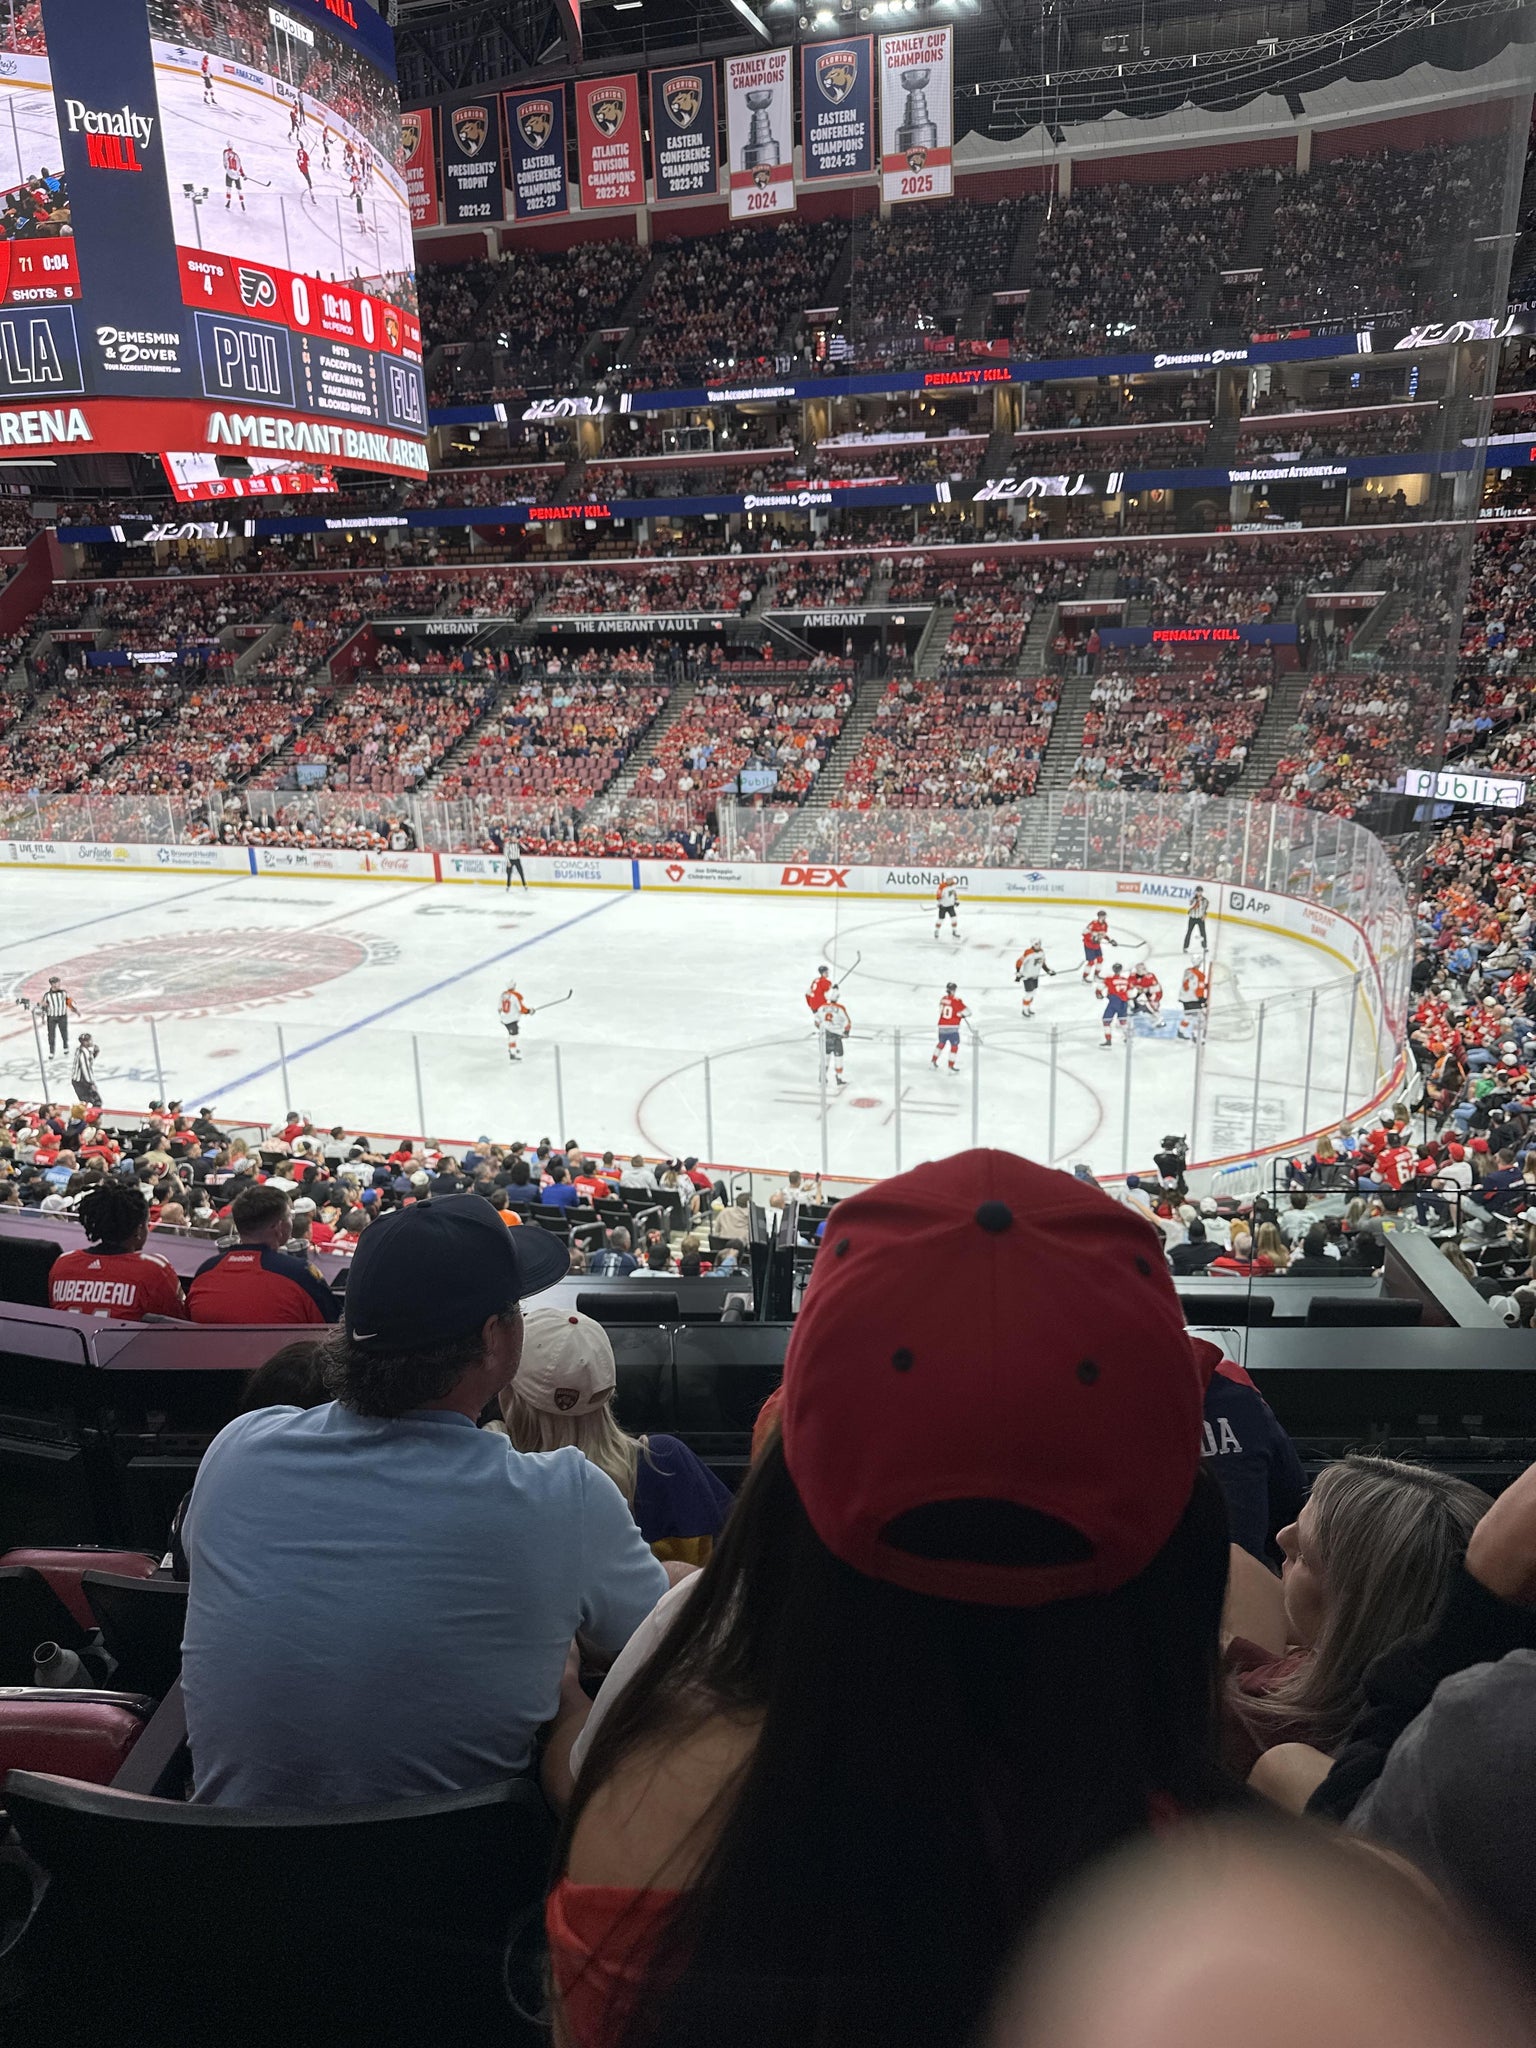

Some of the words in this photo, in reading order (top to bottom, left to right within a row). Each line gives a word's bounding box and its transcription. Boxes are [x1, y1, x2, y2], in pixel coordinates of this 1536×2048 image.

[885, 36, 925, 55] STANLEY
[925, 32, 947, 48] CUP
[730, 60, 768, 76] STANLEY
[768, 54, 787, 69] CUP
[820, 54, 853, 67] FLORIDA
[887, 48, 944, 69] CHAMPIONS
[667, 80, 698, 92] FLORIDA
[732, 69, 785, 90] CHAMPIONS
[593, 91, 622, 102] FLORIDA
[456, 110, 484, 120] FLORIDA
[521, 104, 549, 115] FLORIDA
[817, 108, 857, 127] EASTERN
[64, 99, 153, 149] Penalty
[810, 123, 865, 142] CONFERENCE
[591, 142, 630, 158] ATLANTIC
[667, 133, 703, 150] EASTERN
[811, 139, 864, 157] CHAMPIONS
[86, 133, 142, 171] KILL
[659, 146, 711, 165] CONFERENCE
[448, 161, 497, 177] PRESIDENTS'
[522, 153, 556, 171] EASTERN
[592, 156, 630, 172] DIVISION
[661, 159, 710, 178] CHAMPIONS
[819, 154, 857, 169] 2024-25
[457, 174, 488, 190] TROPHY
[516, 168, 562, 185] CONFERENCE
[587, 170, 636, 186] CHAMPIONS
[901, 174, 933, 195] 2025
[518, 182, 561, 198] CHAMPIONS
[595, 184, 630, 199] 2023-24
[669, 179, 704, 192] 2023-24
[408, 193, 431, 206] PIONS
[526, 195, 557, 210] 2022-23
[747, 191, 777, 211] 2024
[458, 203, 491, 217] 2021-22
[19, 257, 33, 272] 71
[42, 254, 69, 271] 0:04
[187, 261, 224, 277] SHOTS
[12, 287, 58, 300] SHOTS:
[64, 287, 74, 298] 5
[203, 275, 213, 295] 4
[291, 278, 310, 326] 0
[321, 293, 352, 323] 10:10
[360, 298, 375, 344] 0
[0, 319, 64, 385] LA
[105, 347, 117, 359] &
[119, 344, 178, 363] DOVER
[213, 327, 281, 395] PHI
[924, 371, 982, 386] PENALTY
[983, 367, 1012, 381] KILL
[0, 409, 93, 445] RENA
[208, 412, 343, 456] AMERANT
[343, 428, 392, 464] BANK
[391, 437, 429, 472] ARENA
[529, 507, 581, 520] PENALTY
[583, 504, 611, 518] KILL
[574, 622, 597, 633] THE
[598, 621, 655, 632] AMERANT
[658, 619, 699, 630] VAULT
[803, 613, 867, 627] AMERANT
[426, 623, 480, 635] AMERANT
[1152, 629, 1211, 642] PENALTY
[1212, 628, 1241, 641] KILL
[1418, 773, 1503, 805] Publix
[553, 860, 600, 870] COMCAST
[554, 870, 602, 880] BUSINESS
[781, 867, 851, 888] DEX
[886, 871, 969, 887] AutoNaton
[1142, 883, 1197, 899] AMAZIN
[1246, 897, 1271, 915] App
[228, 1255, 254, 1263] Reebok
[53, 1280, 136, 1307] HUBERDEAU
